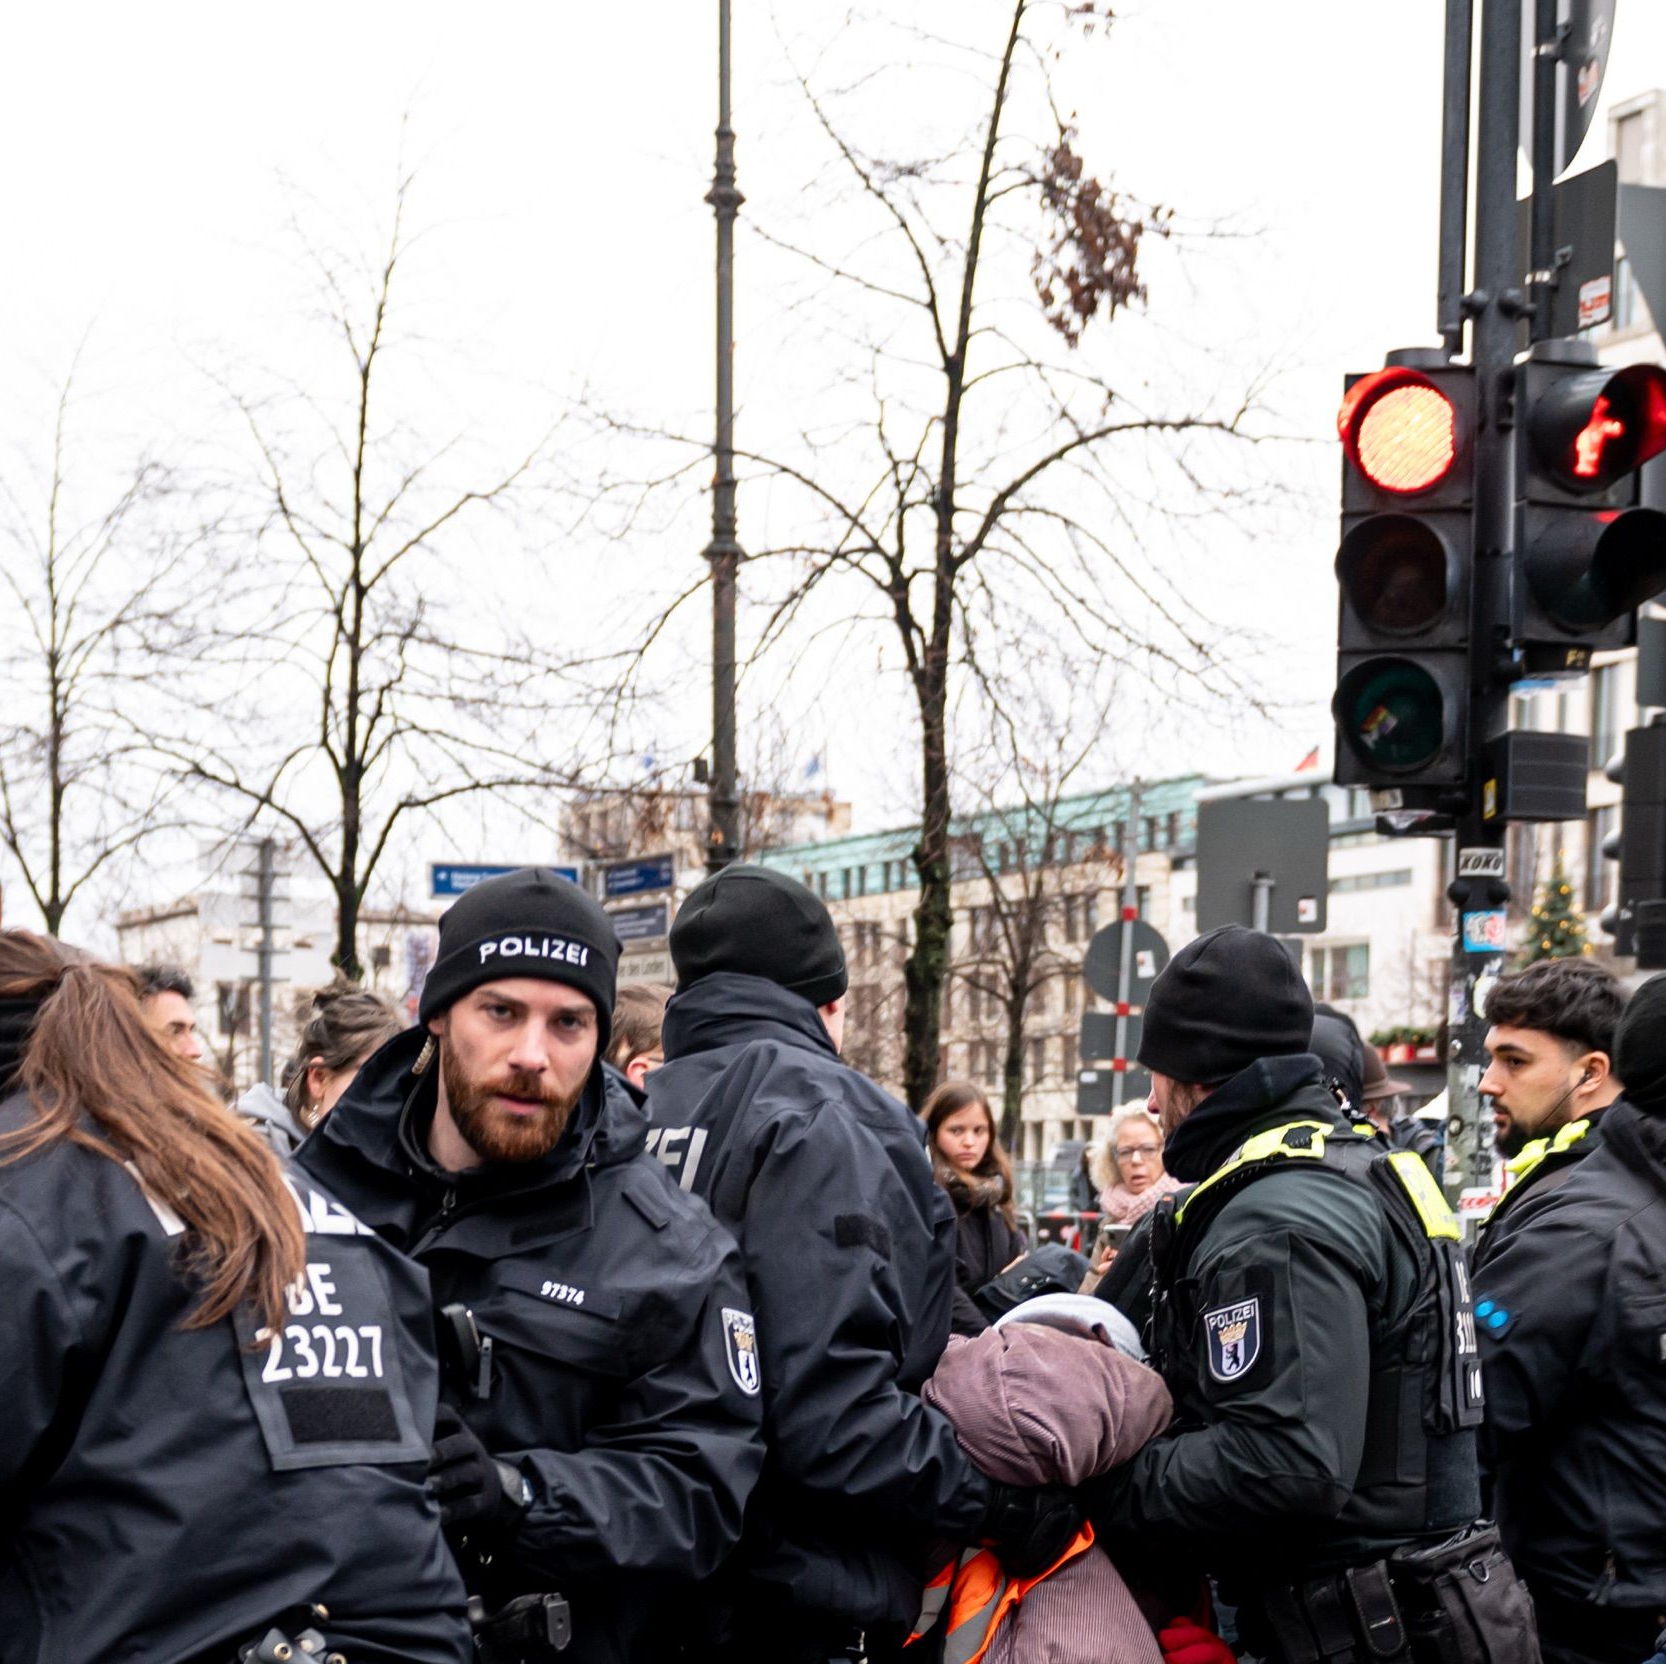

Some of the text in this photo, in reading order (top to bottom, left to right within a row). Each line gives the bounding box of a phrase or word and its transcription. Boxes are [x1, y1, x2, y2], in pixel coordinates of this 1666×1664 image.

[479, 937, 589, 966] POLIZEI
[285, 1263, 342, 1315] BE
[540, 1280, 585, 1305] 97374
[1209, 1304, 1255, 1330] POLIZEI
[255, 1324, 383, 1383] 23227
